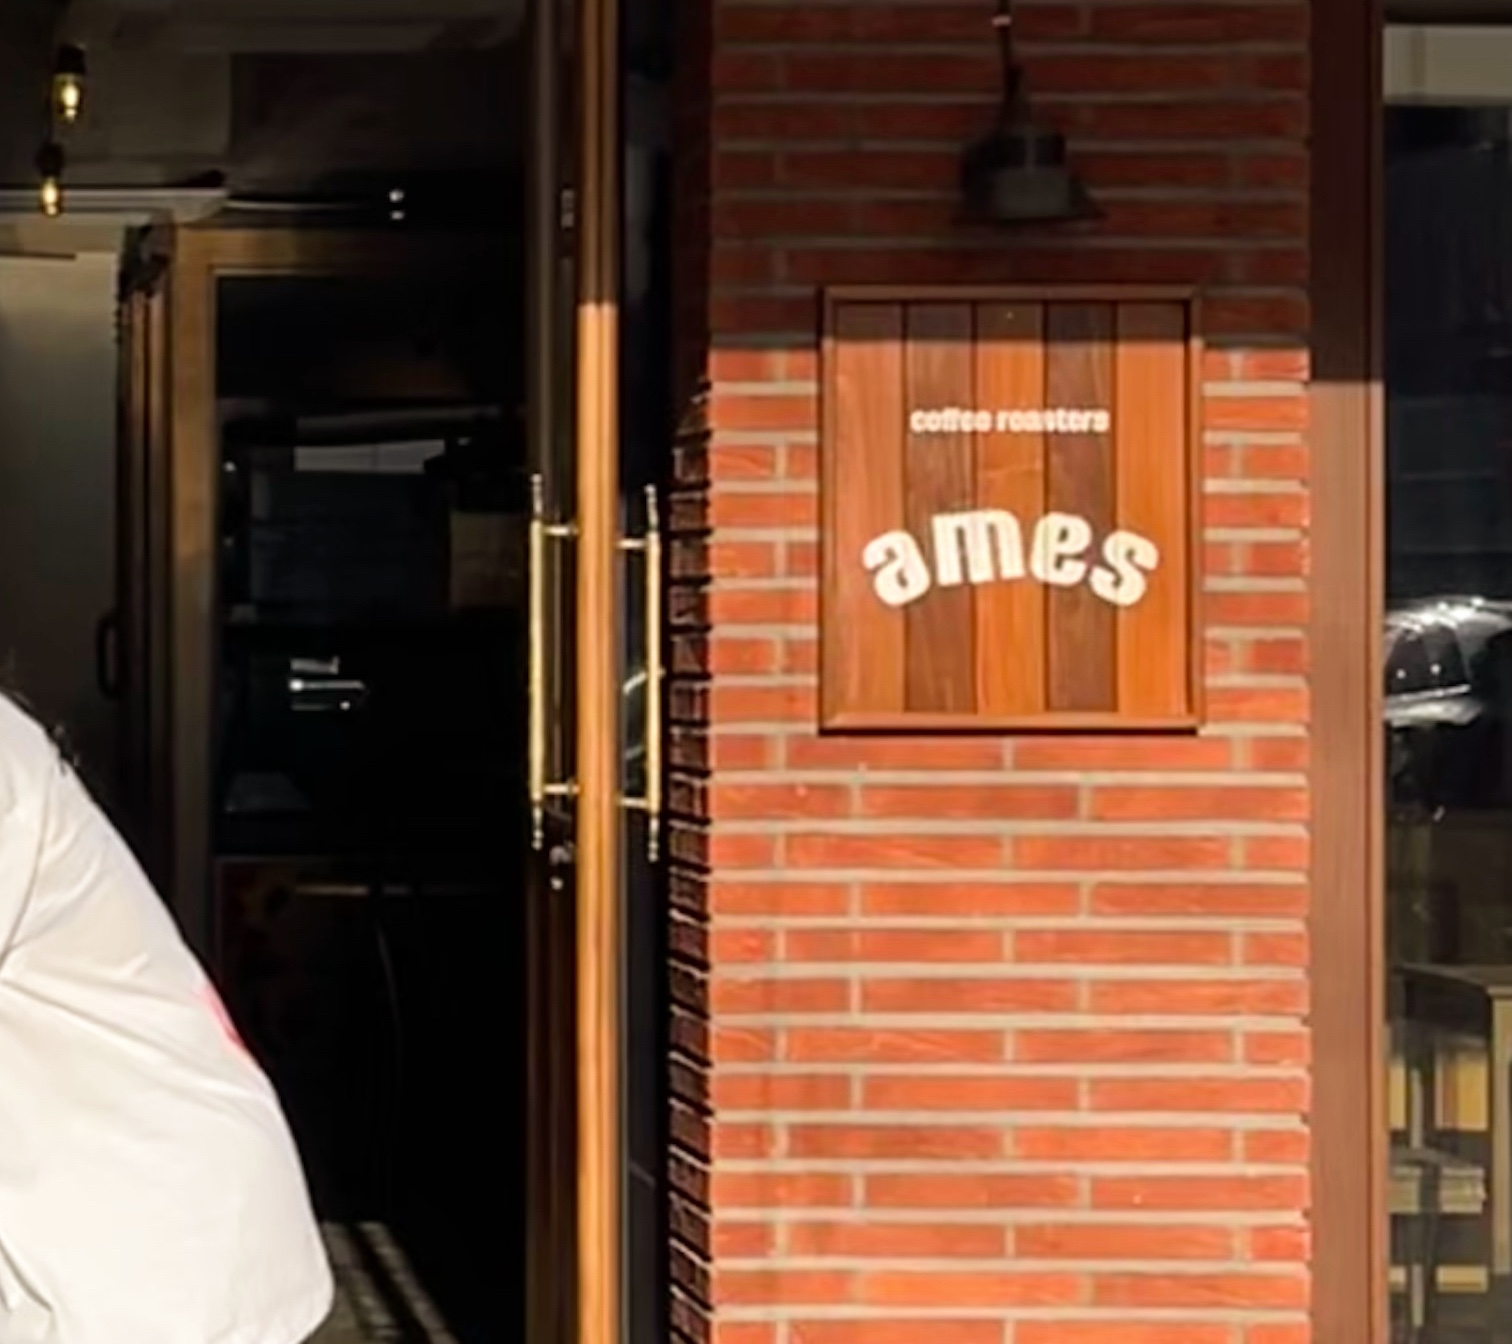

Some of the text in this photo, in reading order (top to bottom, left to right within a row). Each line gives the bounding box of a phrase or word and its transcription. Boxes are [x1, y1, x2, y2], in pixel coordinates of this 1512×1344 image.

[910, 408, 1110, 432] coffee roasters
[862, 509, 1159, 607] ames
